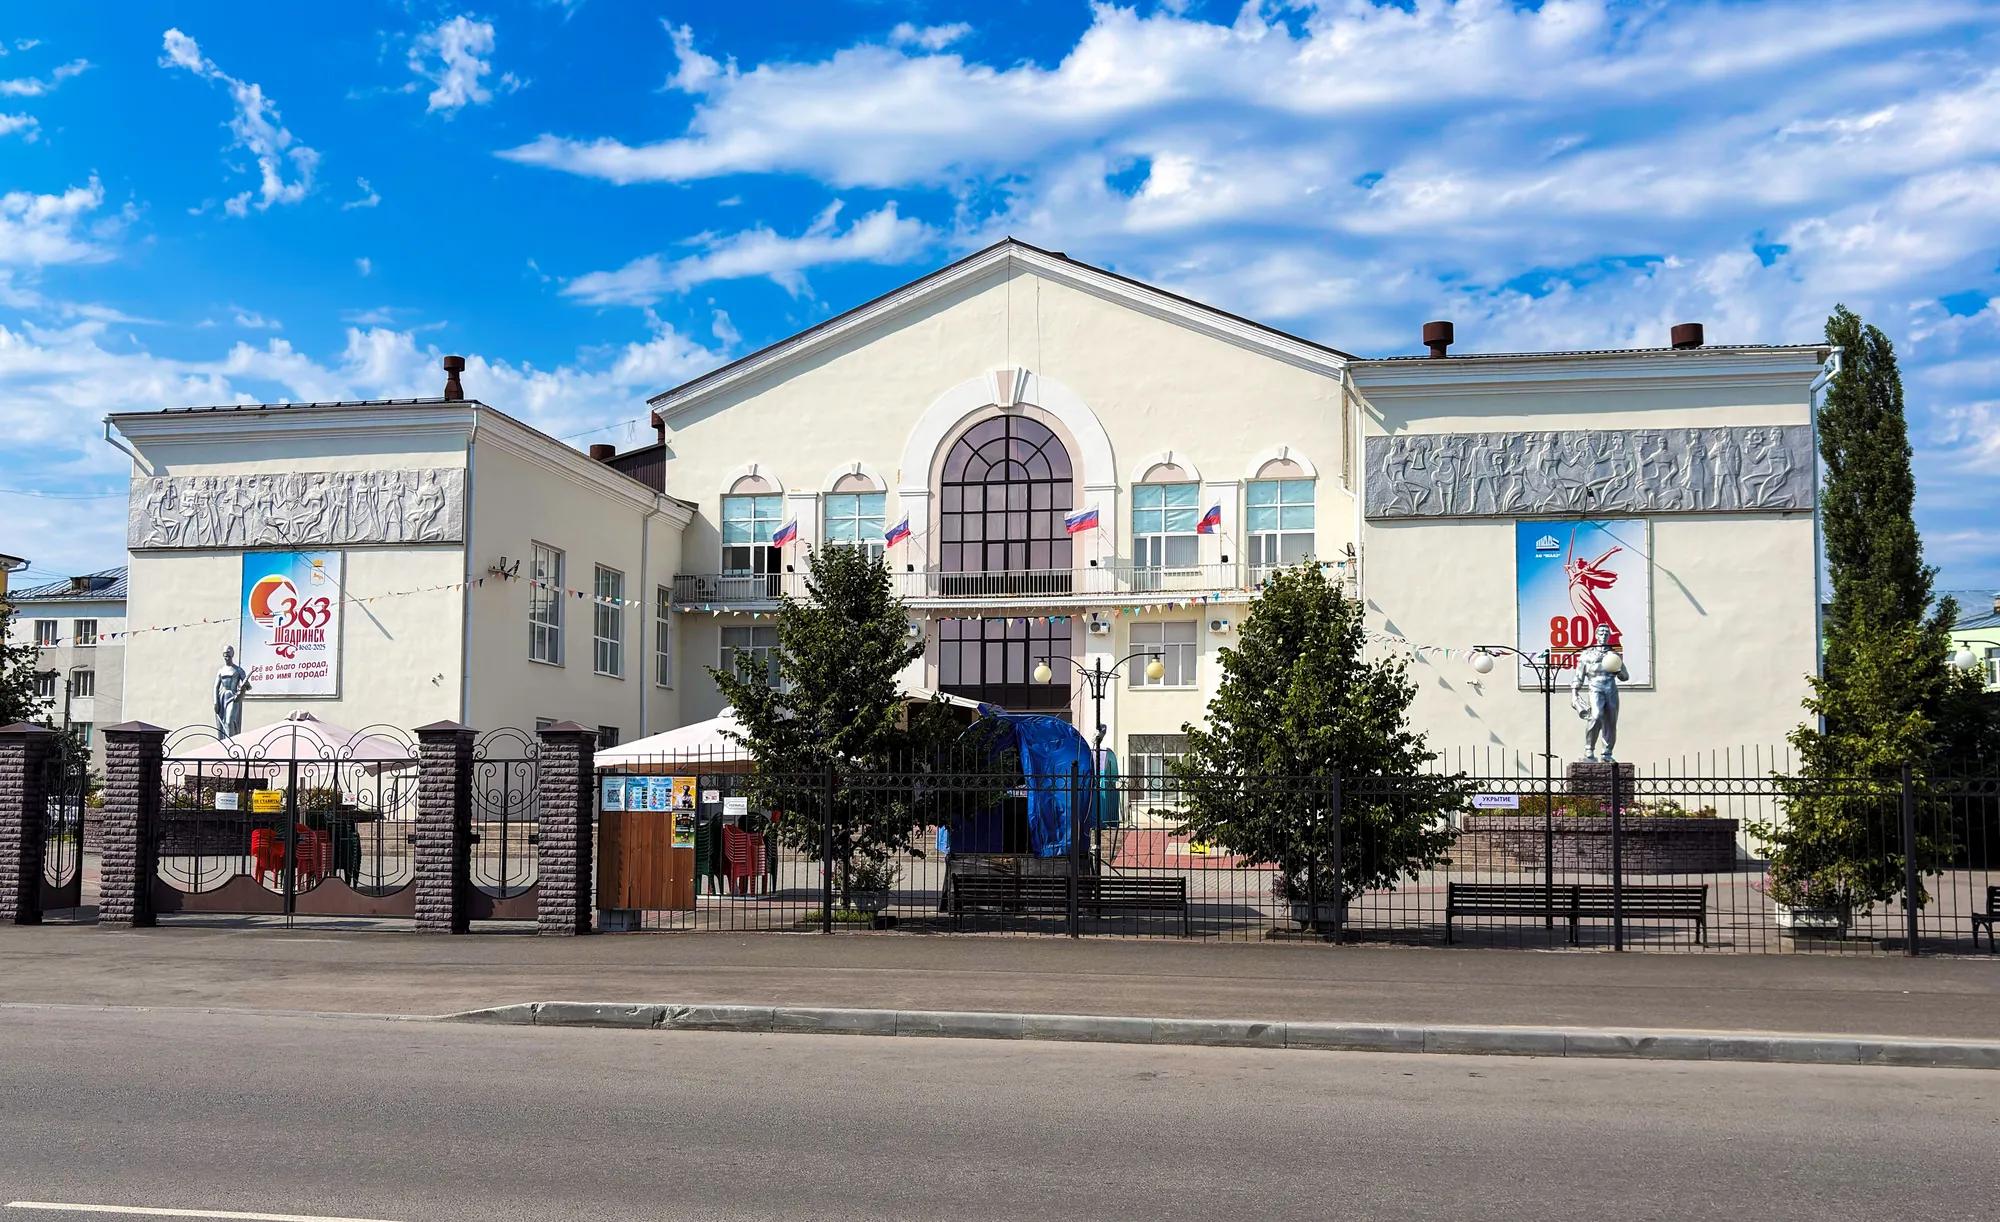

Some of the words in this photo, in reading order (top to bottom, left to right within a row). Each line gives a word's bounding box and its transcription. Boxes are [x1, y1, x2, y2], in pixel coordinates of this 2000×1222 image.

[280, 597, 331, 629] 363
[274, 627, 325, 648] Шадринск
[1550, 615, 1589, 648] 80
[250, 672, 263, 681] всё
[265, 673, 275, 681] во
[276, 672, 292, 680] имя
[294, 667, 329, 680] города!
[275, 662, 296, 671] благо
[298, 660, 329, 669] города,
